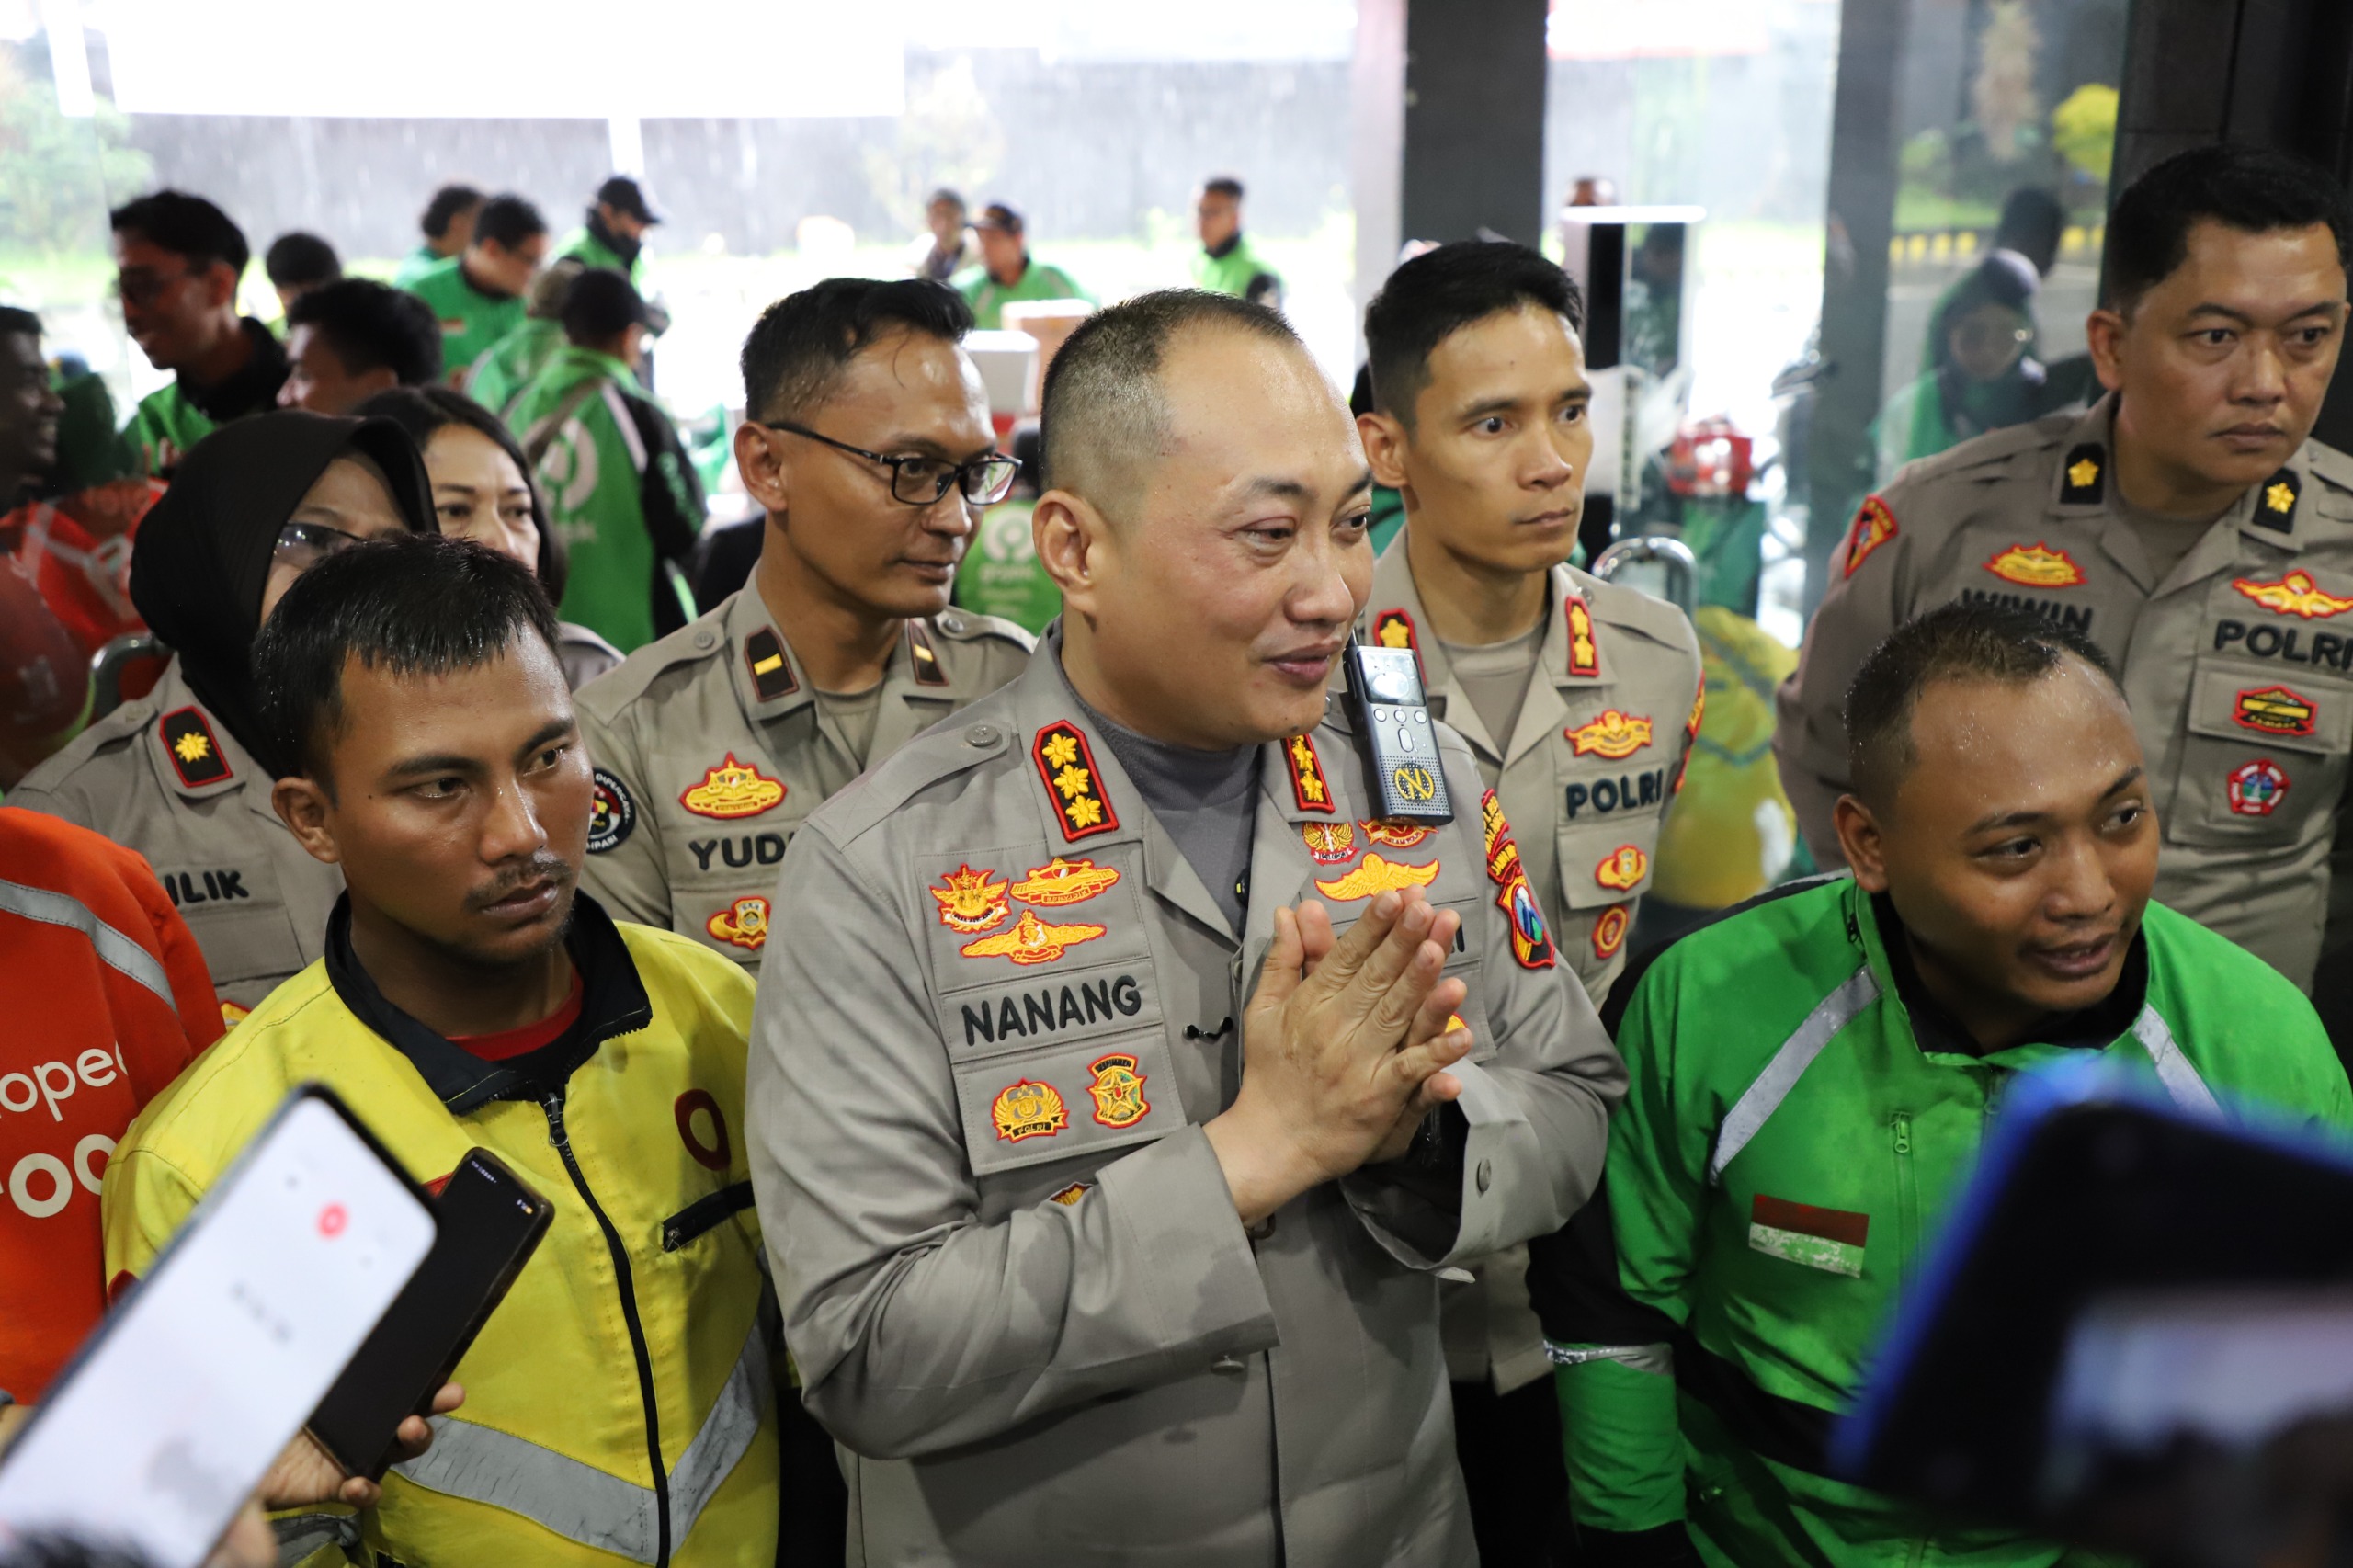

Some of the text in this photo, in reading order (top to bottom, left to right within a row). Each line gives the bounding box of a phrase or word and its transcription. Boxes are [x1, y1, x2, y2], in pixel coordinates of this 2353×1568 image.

[2214, 619, 2353, 671] POLRI
[1566, 768, 1663, 818] POLRI
[688, 831, 794, 871] YUD
[961, 975, 1141, 1046] NANANG
[0, 1040, 129, 1122] ope
[1017, 1123, 1046, 1134] POLRI
